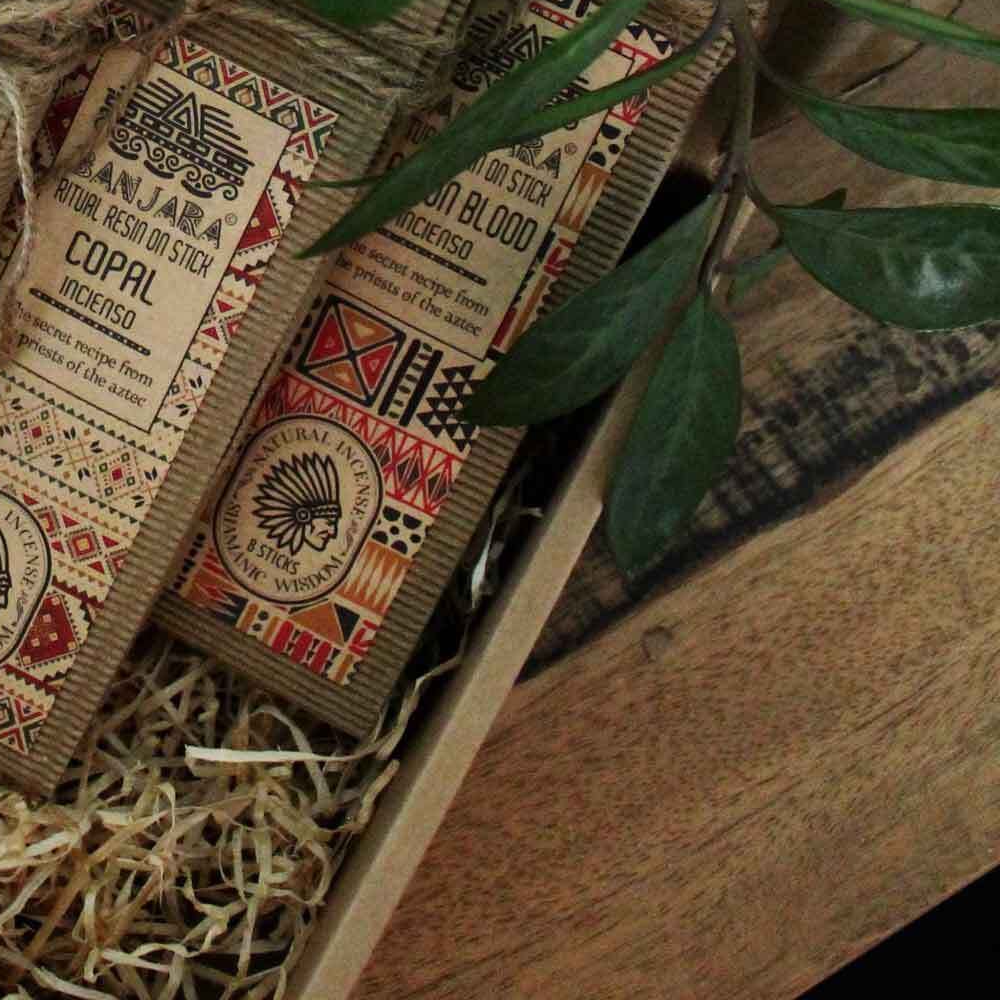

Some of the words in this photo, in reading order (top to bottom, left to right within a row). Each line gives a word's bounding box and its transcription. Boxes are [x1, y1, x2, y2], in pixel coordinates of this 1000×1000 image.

[484, 159, 508, 186] ON
[507, 169, 552, 207] STICK
[54, 178, 102, 222] RITUAL
[102, 205, 148, 245] RESIN
[146, 228, 170, 257] ON
[168, 240, 214, 278] STICK
[458, 190, 538, 252] BLOOD
[59, 275, 136, 330] INCIENSO
[65, 231, 156, 306] COPAL
[352, 265, 399, 296] priests
[401, 289, 419, 305] of
[419, 298, 442, 318] the
[444, 311, 482, 337] aztec
[367, 248, 408, 275] secret
[410, 270, 453, 298] recipe
[454, 290, 489, 317] from
[17, 333, 64, 366] priests
[66, 356, 85, 373] of
[83, 367, 106, 388] the
[108, 383, 147, 408] aztec
[32, 317, 72, 345] secret
[74, 339, 117, 369] recipe
[119, 360, 153, 388] from
[253, 428, 331, 465] NATURAL
[336, 440, 371, 520] INCENSE
[4, 510, 40, 592] INCENSE
[223, 501, 267, 581] SHAMANIC
[274, 554, 344, 593] WISDOM
[247, 538, 257, 553] 8
[256, 544, 300, 575] STICKS
